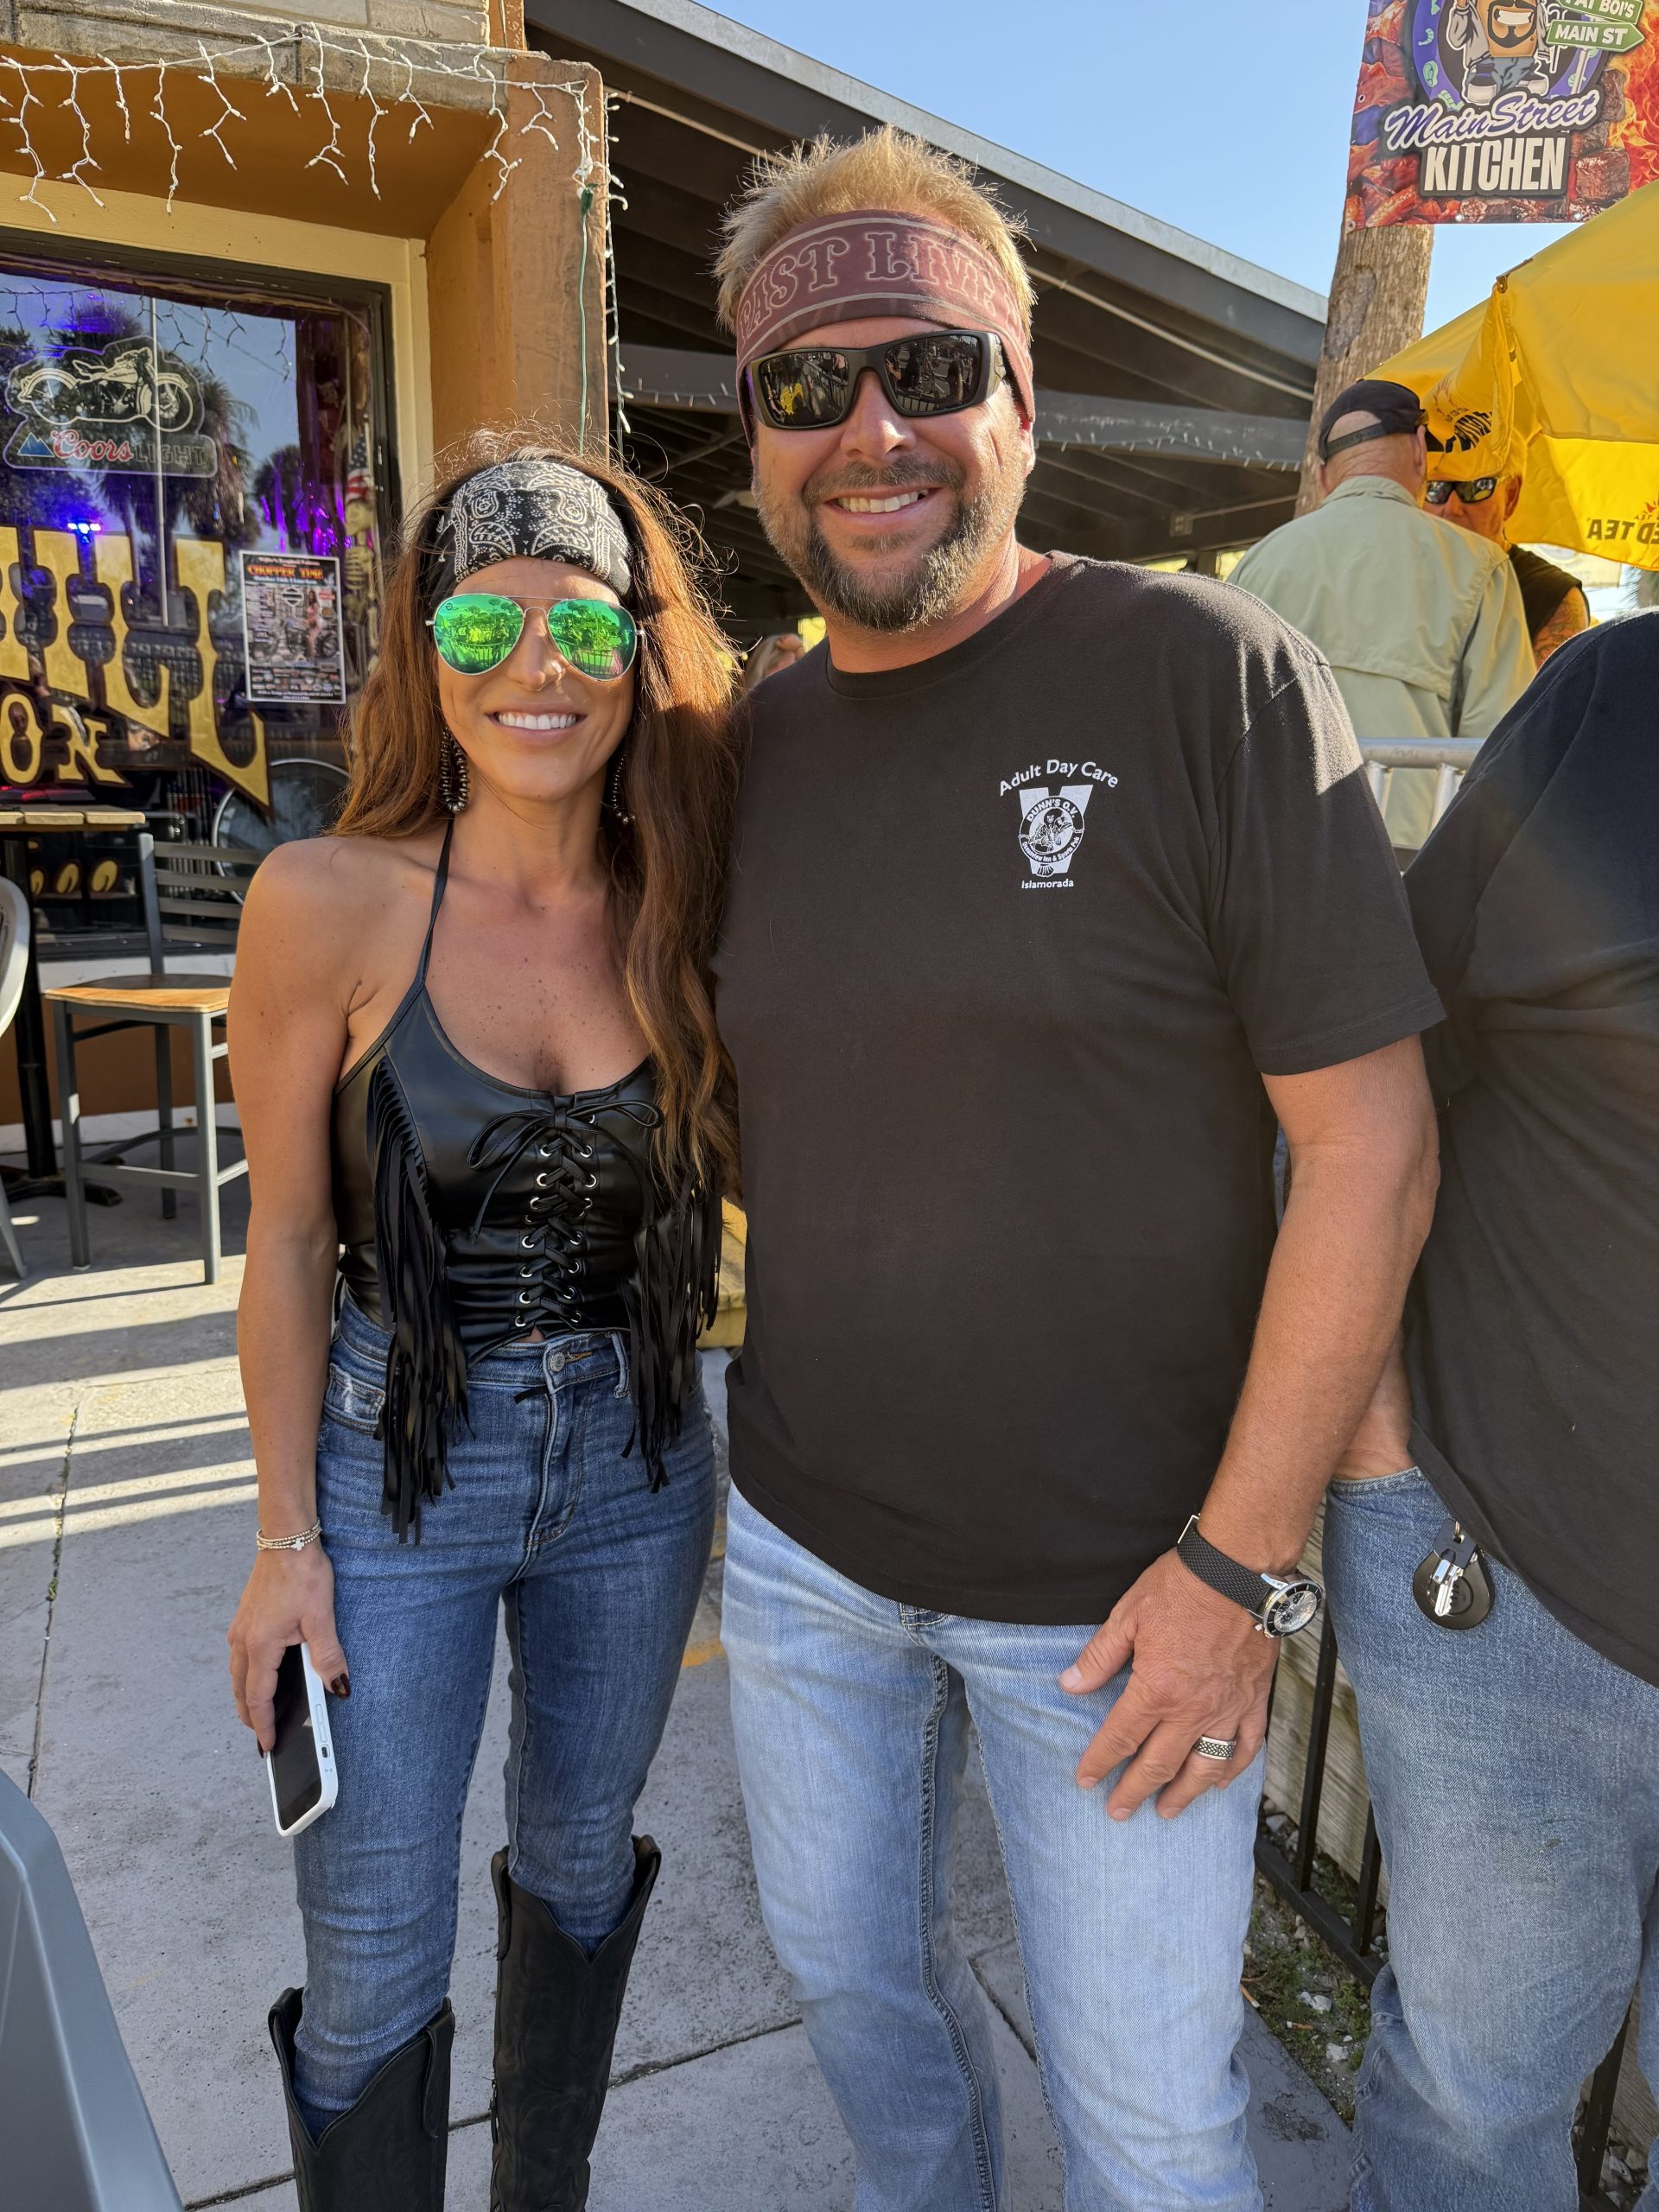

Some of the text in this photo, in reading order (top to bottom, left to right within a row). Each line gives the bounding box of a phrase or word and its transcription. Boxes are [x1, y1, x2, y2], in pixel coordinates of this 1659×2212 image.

[1599, 0, 1636, 18] BOI'S
[1555, 24, 1629, 45] MAIN ST
[1425, 137, 1566, 191] KITCHEN
[739, 238, 849, 343] FAST
[51, 429, 207, 466] Coors LIGHT
[1000, 760, 1118, 797] Adult Day Care
[1027, 798, 1061, 822] DUNN'S
[1021, 879, 1074, 889] Islamorada
